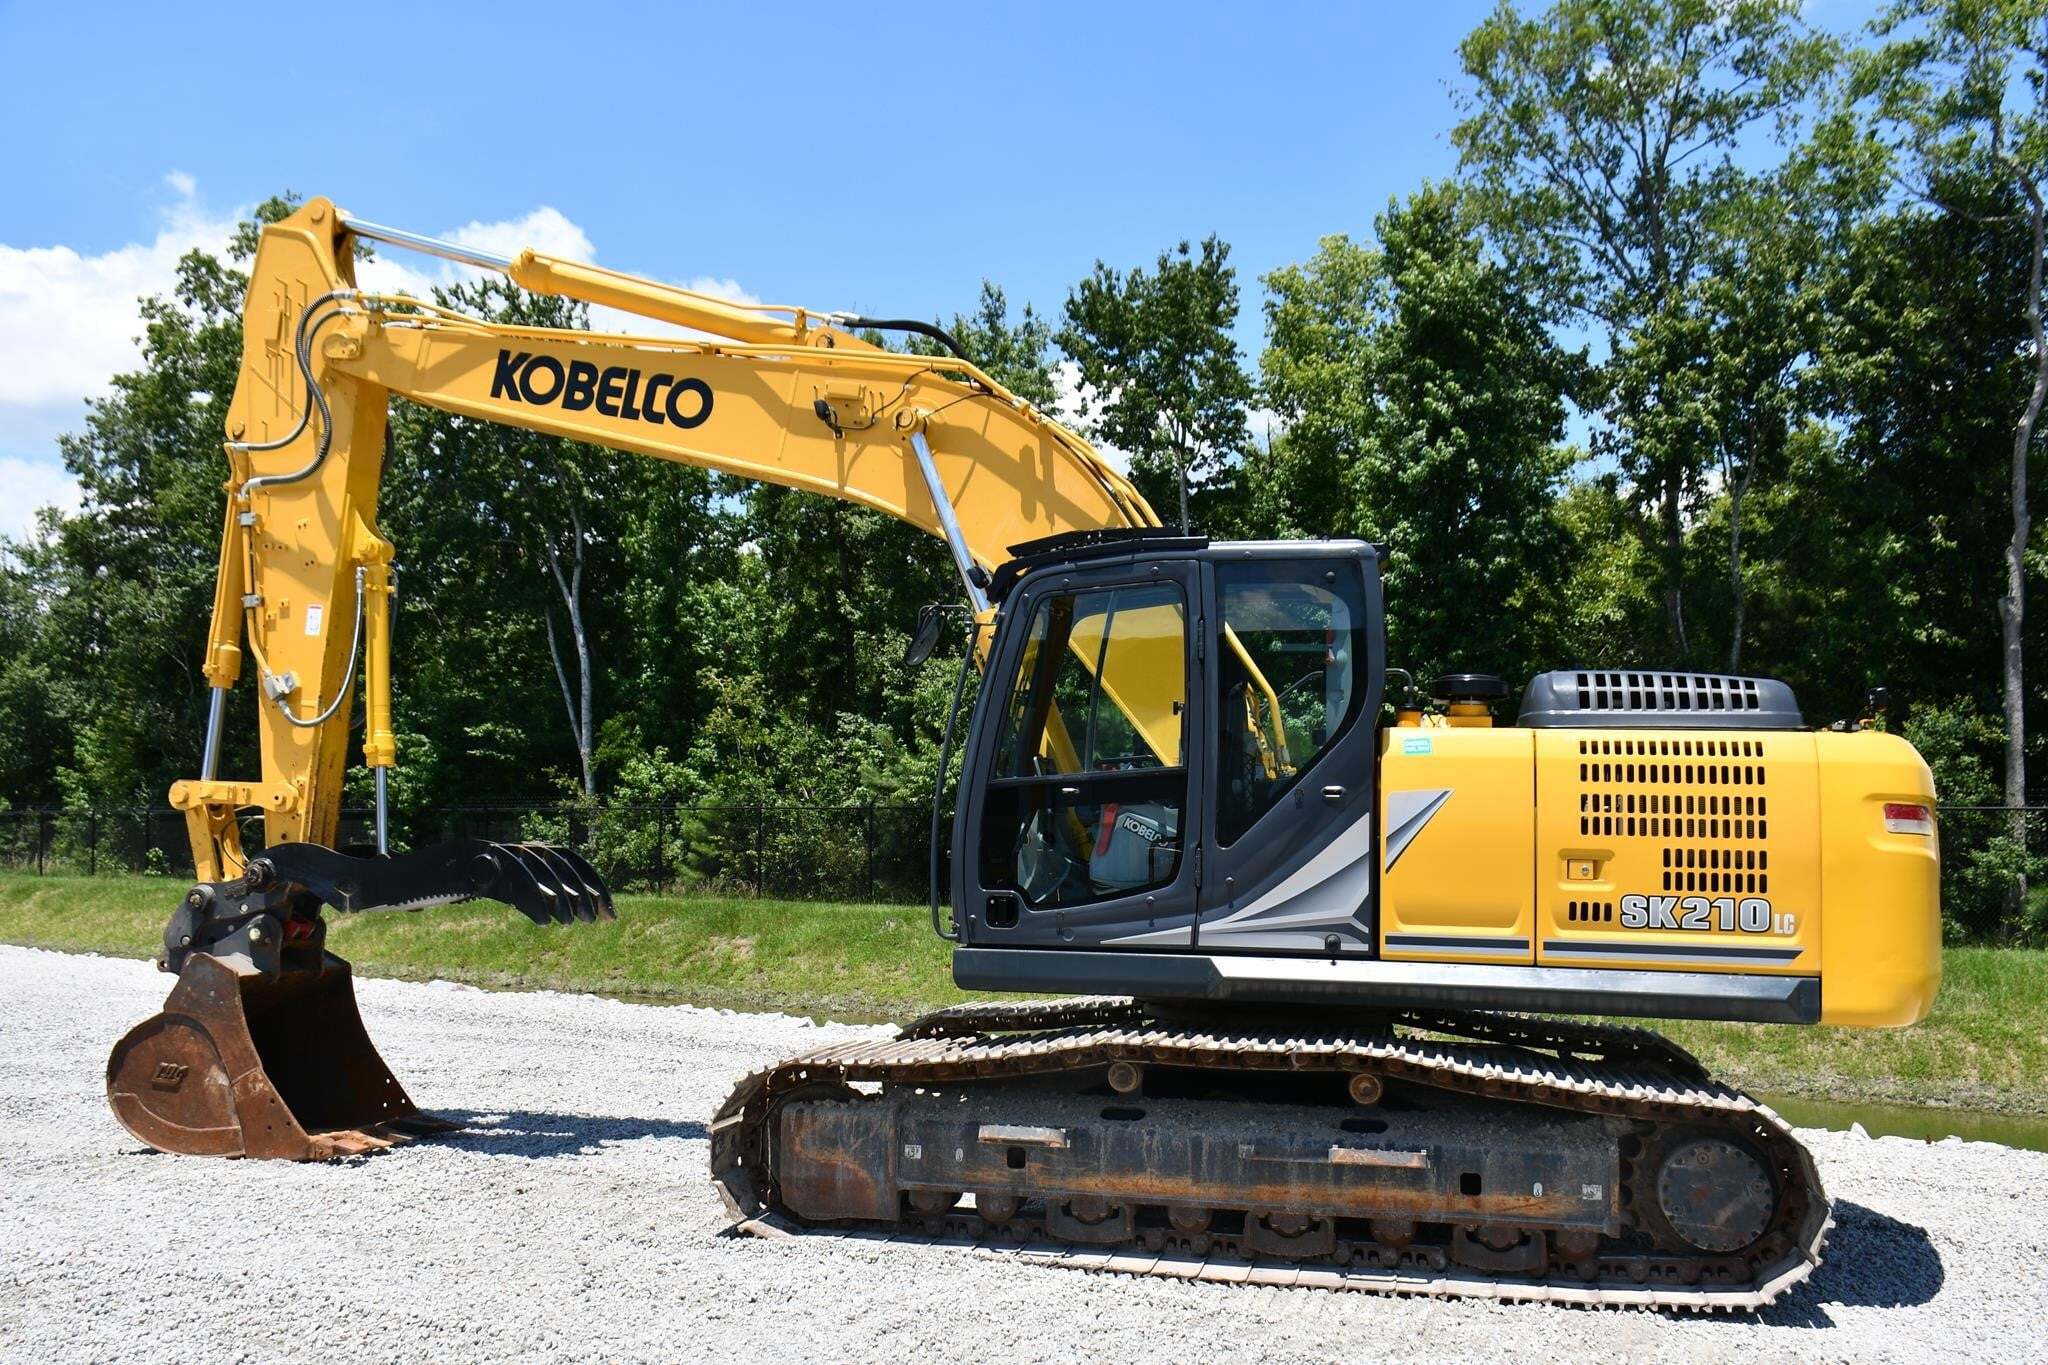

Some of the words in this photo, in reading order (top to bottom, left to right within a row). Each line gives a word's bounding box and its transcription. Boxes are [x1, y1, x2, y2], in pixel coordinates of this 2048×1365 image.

[490, 349, 714, 429] KOBELCO
[1620, 895, 1771, 932] SK210
[1774, 913, 1795, 934] LC
